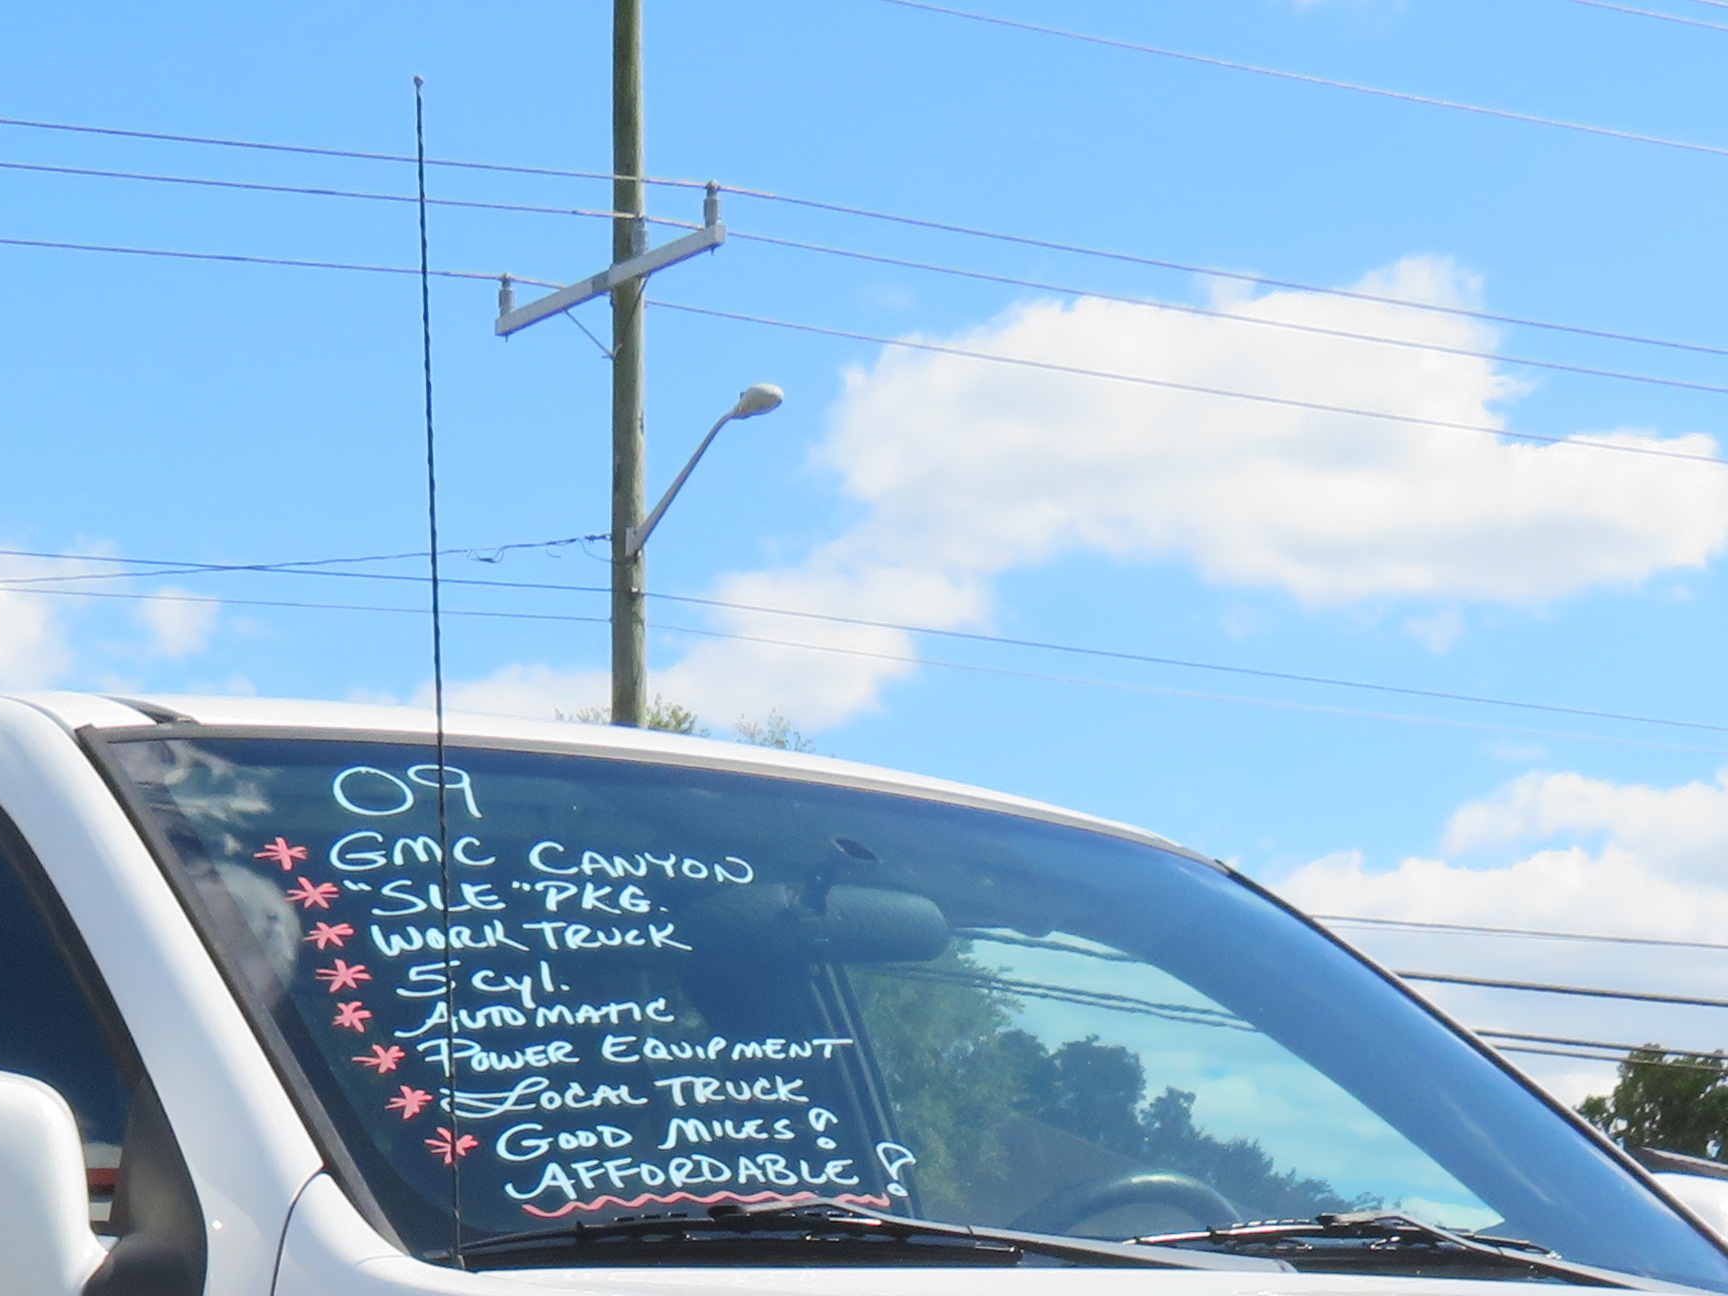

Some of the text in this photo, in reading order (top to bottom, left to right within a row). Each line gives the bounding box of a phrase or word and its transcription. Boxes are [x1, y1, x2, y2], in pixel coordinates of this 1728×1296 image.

[332, 763, 483, 819] 09
[328, 830, 756, 885] GMC CANYON
[370, 919, 694, 958] WORK TRUCK
[395, 959, 463, 998] 5
[394, 996, 676, 1038] AUTOMATIC
[416, 1033, 856, 1078] POWER EQUIPMENT
[439, 1074, 810, 1119] LOCAL TRUCK
[495, 1122, 635, 1163] GOOD
